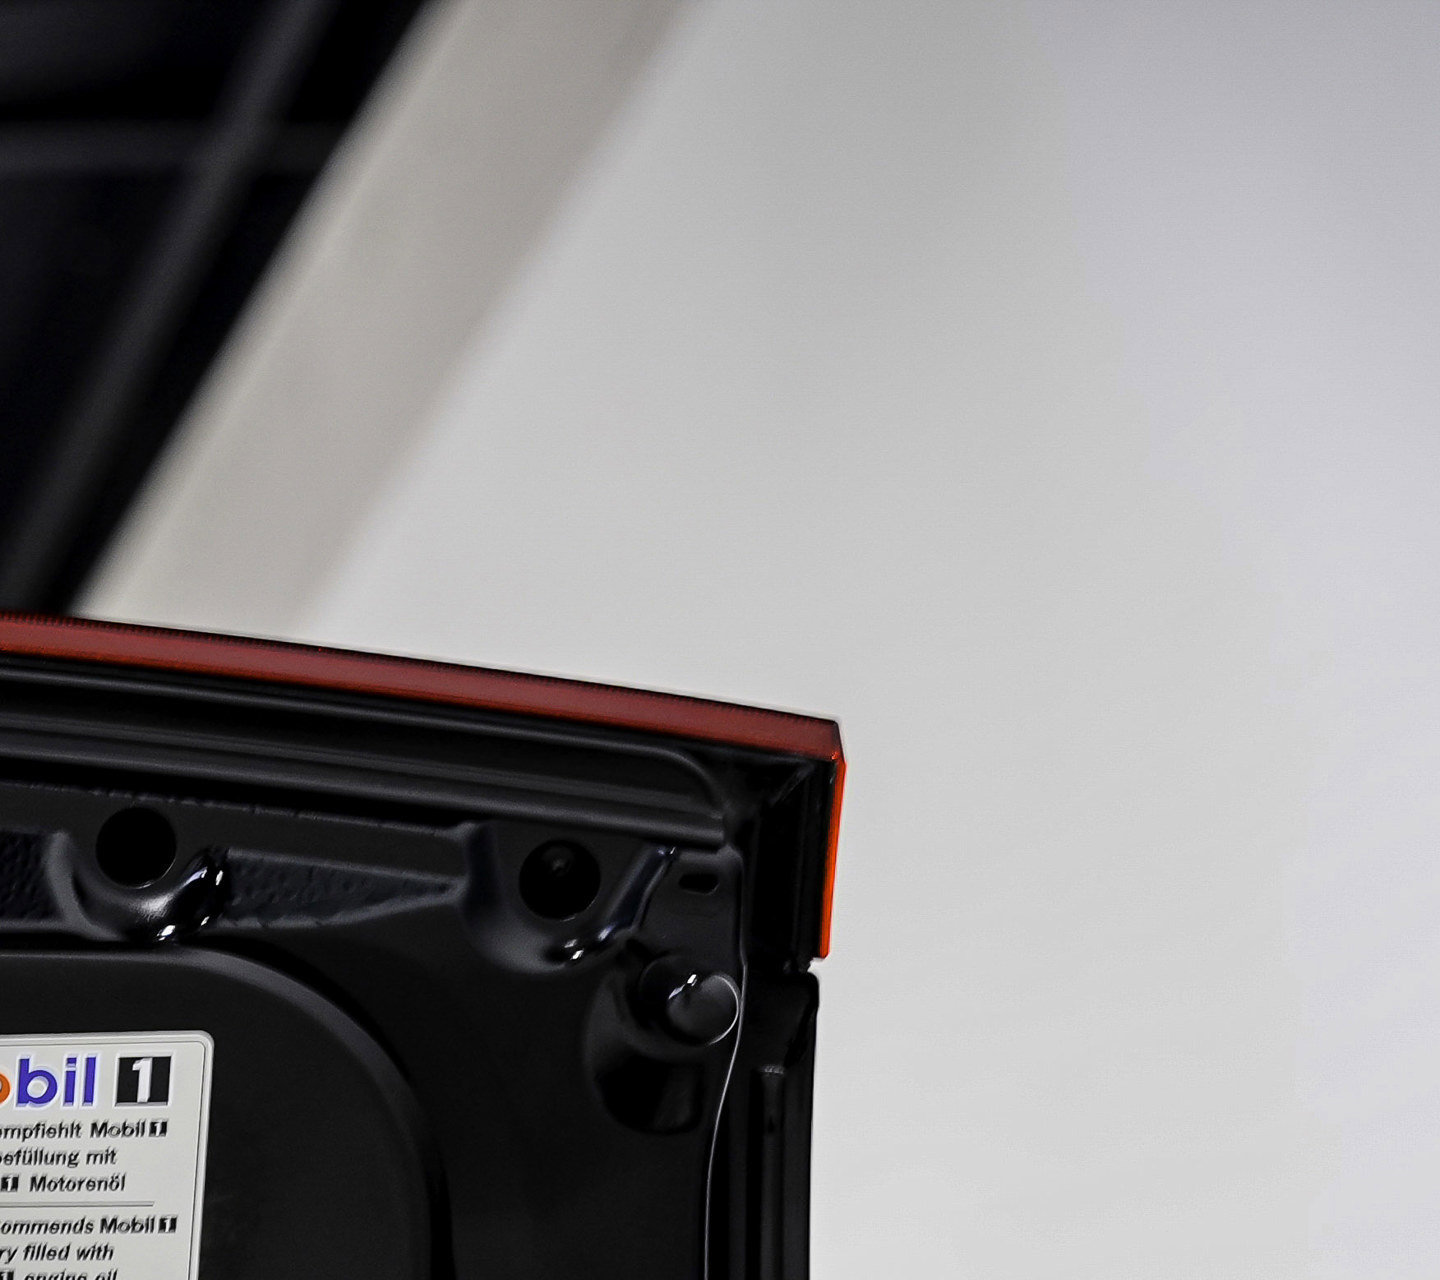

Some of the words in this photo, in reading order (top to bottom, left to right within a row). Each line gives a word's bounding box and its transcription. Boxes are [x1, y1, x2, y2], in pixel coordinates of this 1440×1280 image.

[86, 1146, 119, 1165] mit
[29, 1172, 127, 1192] Motorenöl
[23, 1242, 71, 1261] filled
[76, 1242, 114, 1261] with
